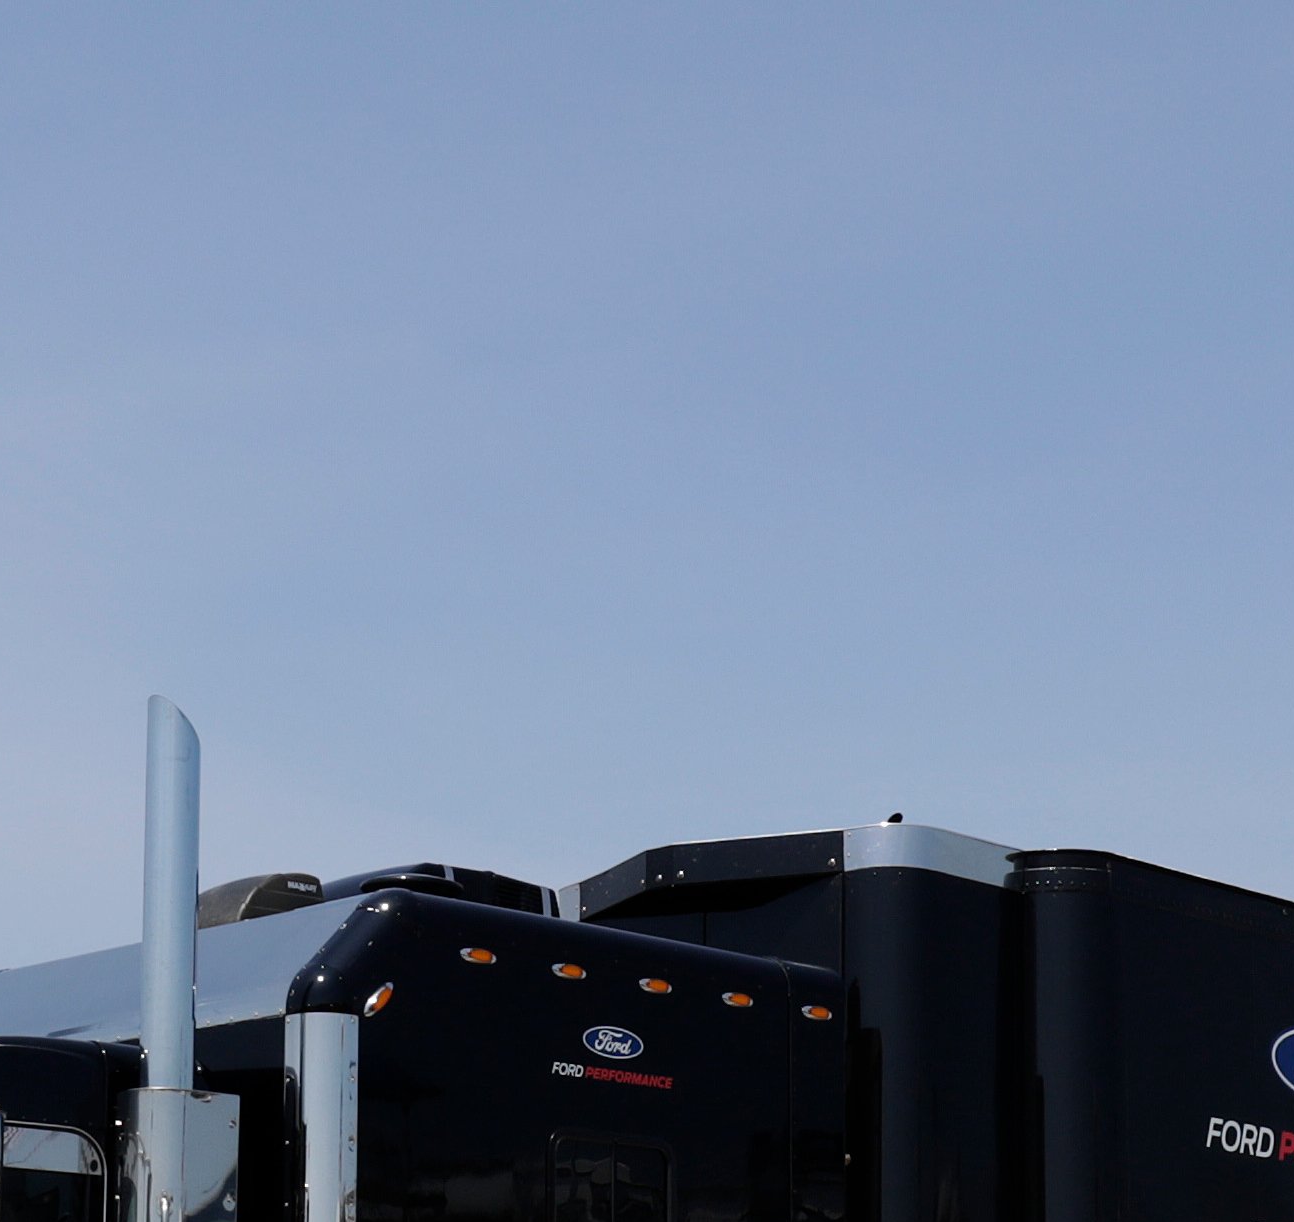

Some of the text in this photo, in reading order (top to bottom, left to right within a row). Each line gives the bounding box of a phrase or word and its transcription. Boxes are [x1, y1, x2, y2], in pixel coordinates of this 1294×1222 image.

[594, 1030, 632, 1055] Ford
[551, 1061, 674, 1089] FORD PERFORMANCE
[1206, 1117, 1275, 1158] FORD
